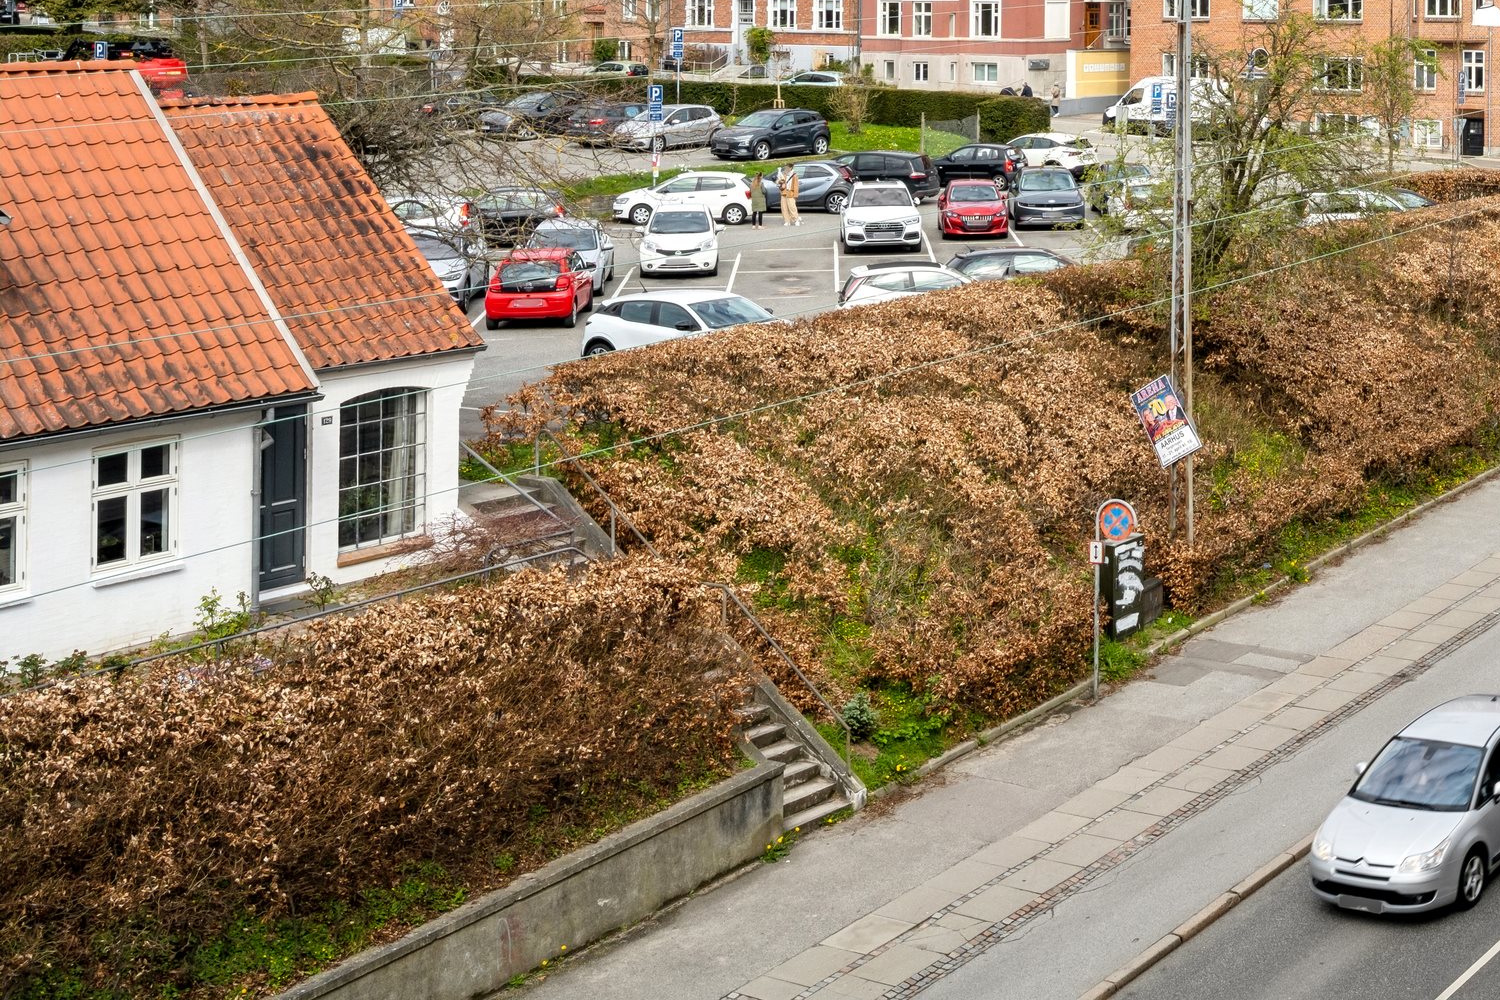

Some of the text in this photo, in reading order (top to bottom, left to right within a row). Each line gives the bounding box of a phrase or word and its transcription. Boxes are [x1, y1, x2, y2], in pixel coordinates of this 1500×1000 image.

[675, 30, 682, 41] P
[96, 43, 103, 57] P
[652, 87, 660, 101] P
[1154, 86, 1160, 97] P
[1168, 94, 1176, 107] P
[1136, 379, 1166, 403] ARENA
[1148, 399, 1167, 416] 70
[1160, 430, 1185, 449] AARHUS
